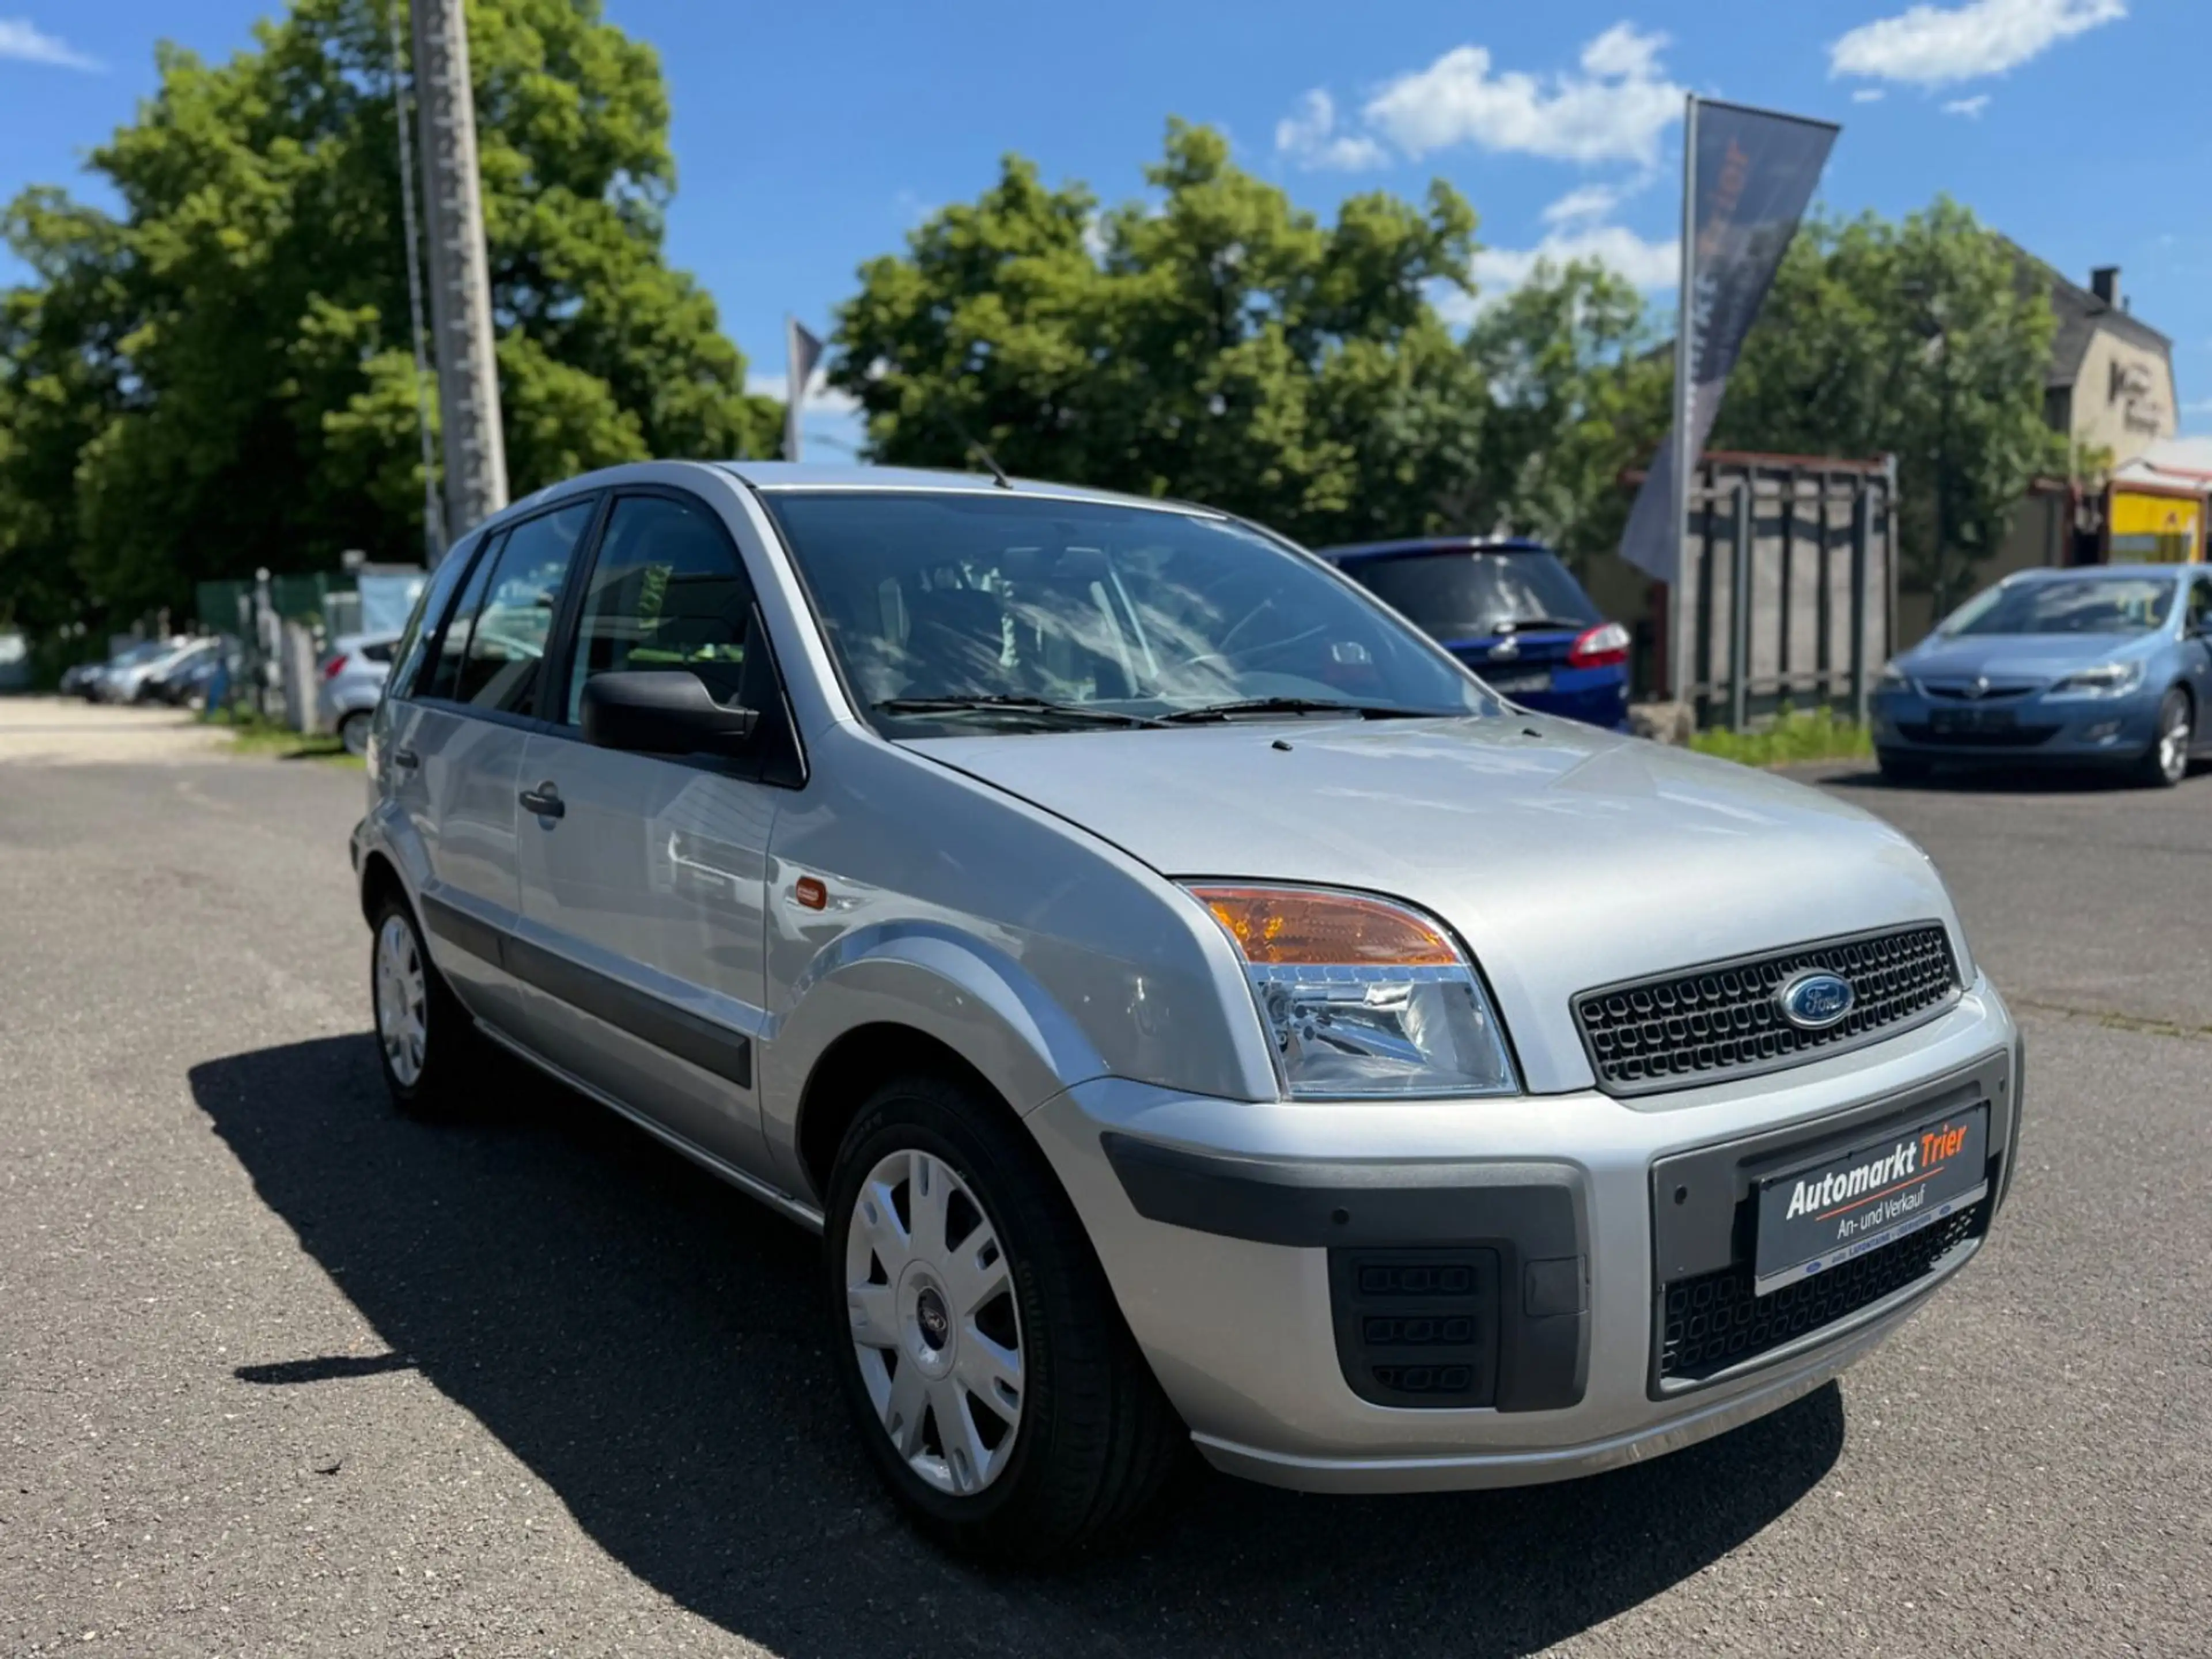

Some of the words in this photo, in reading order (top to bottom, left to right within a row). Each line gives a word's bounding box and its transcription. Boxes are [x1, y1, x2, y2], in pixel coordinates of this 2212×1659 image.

[1805, 984, 1844, 1014] Ford
[1786, 1141, 1917, 1221] Automarkt
[1921, 1123, 1967, 1167] Trier
[1837, 1218, 1858, 1240] An-
[1861, 1205, 1883, 1230] und
[1885, 1183, 1926, 1221] Verkauf
